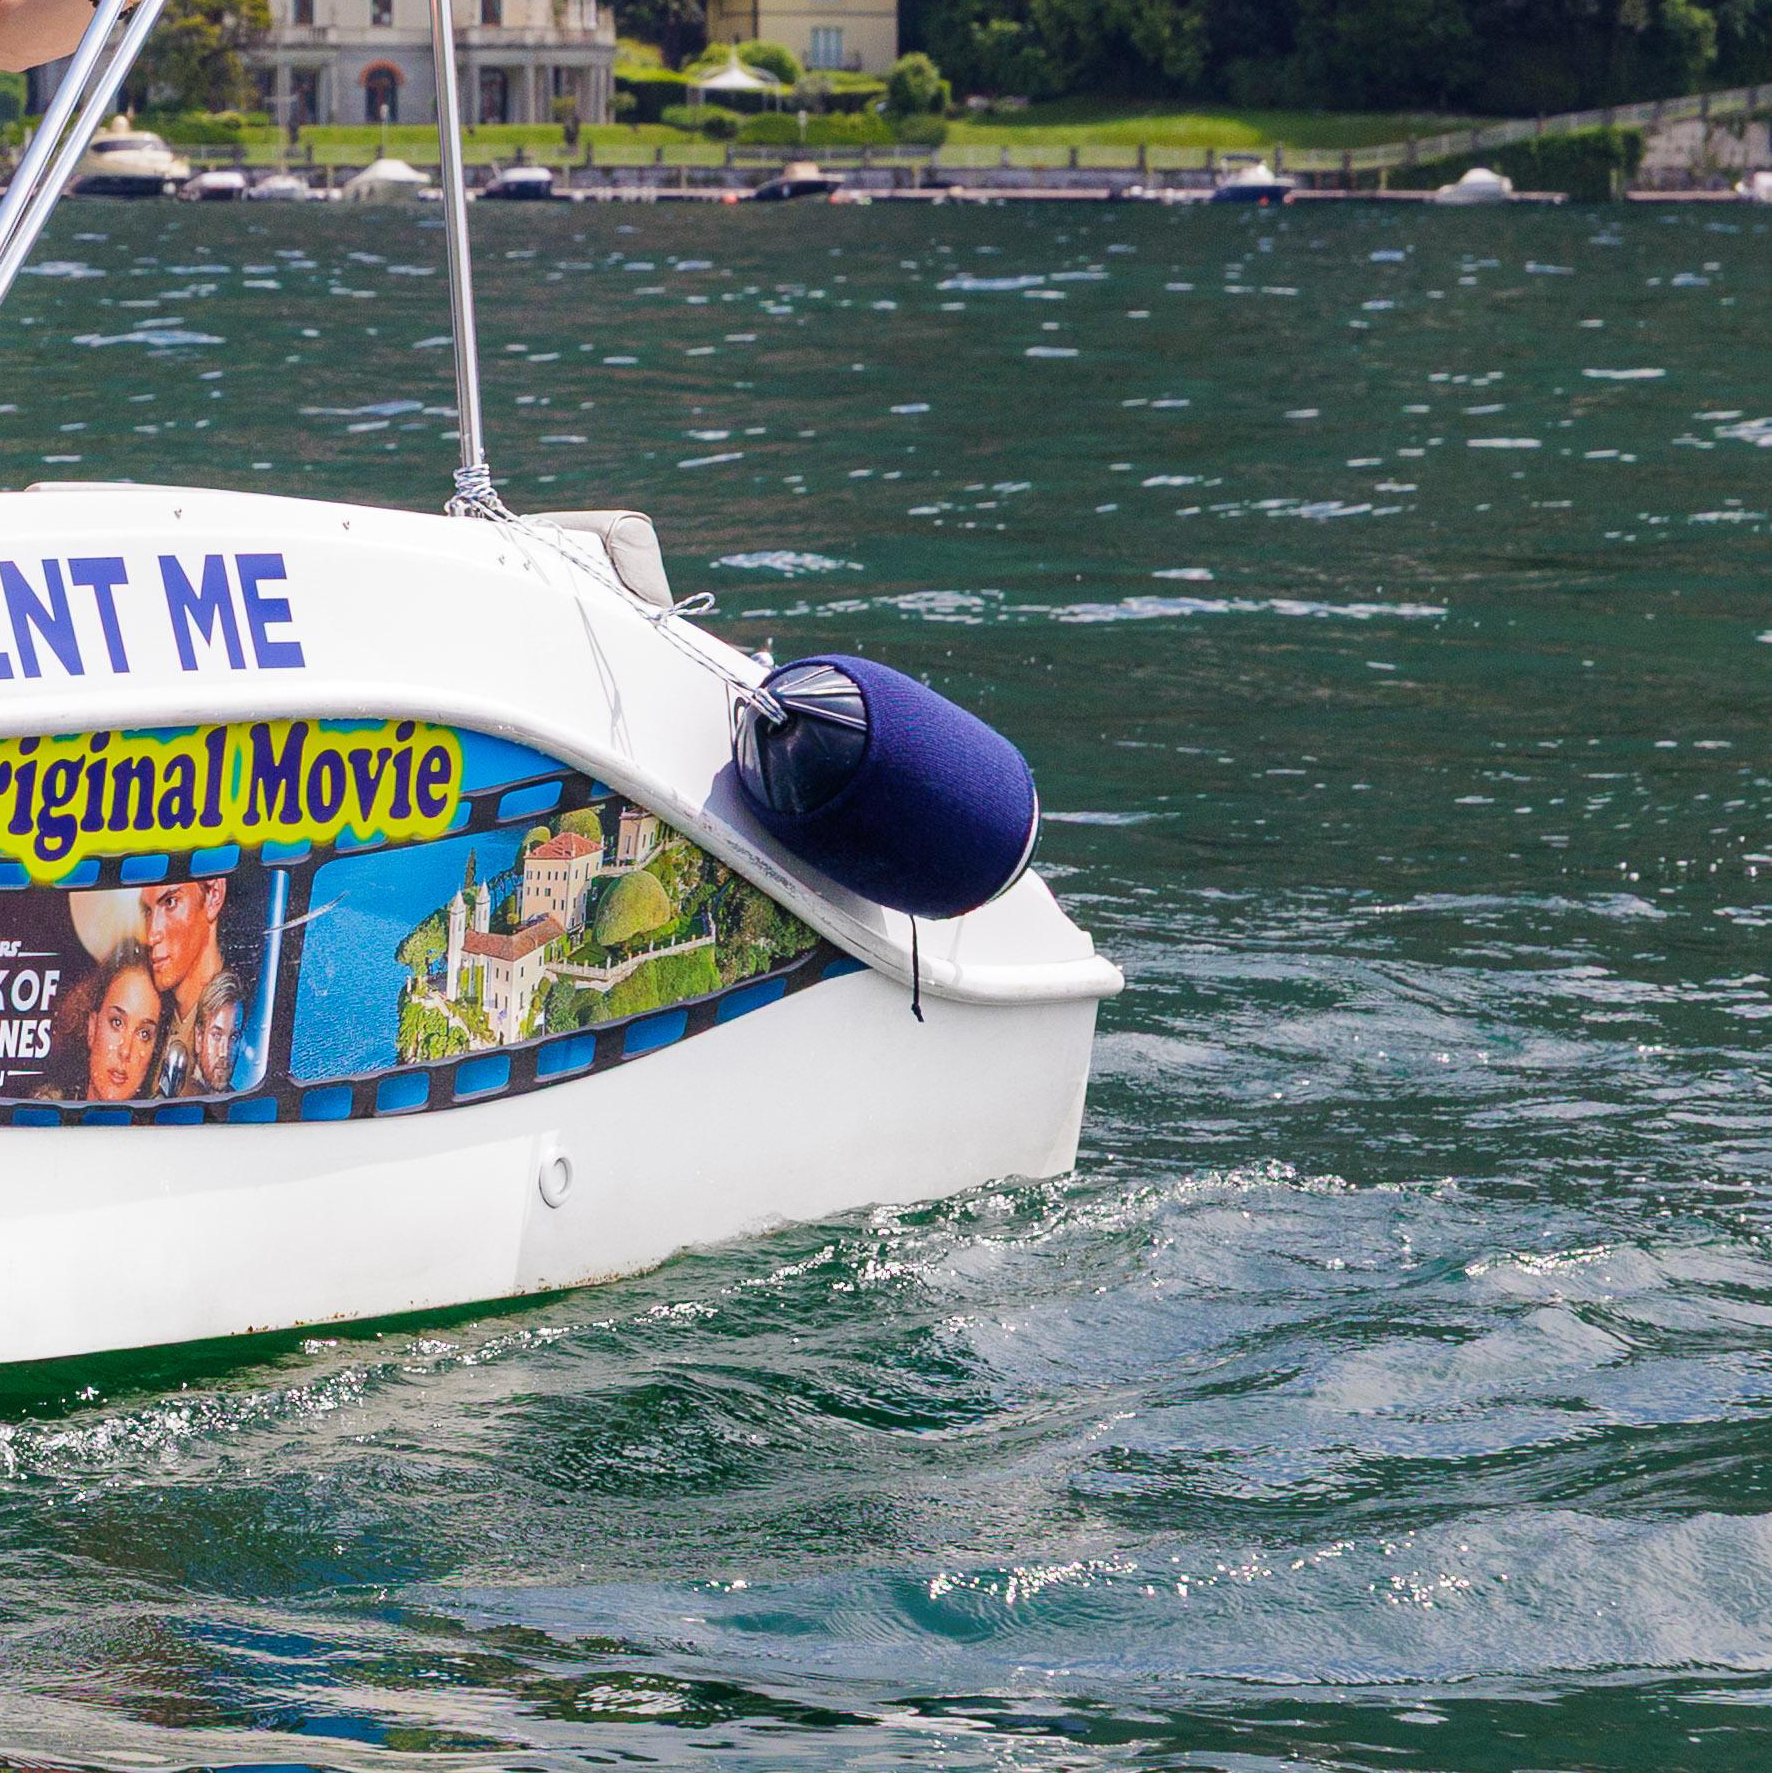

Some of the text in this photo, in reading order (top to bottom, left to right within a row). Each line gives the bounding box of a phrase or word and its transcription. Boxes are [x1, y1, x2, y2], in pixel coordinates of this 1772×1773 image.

[157, 553, 307, 671] ME
[242, 720, 453, 828] Movie
[11, 969, 61, 1012] OF
